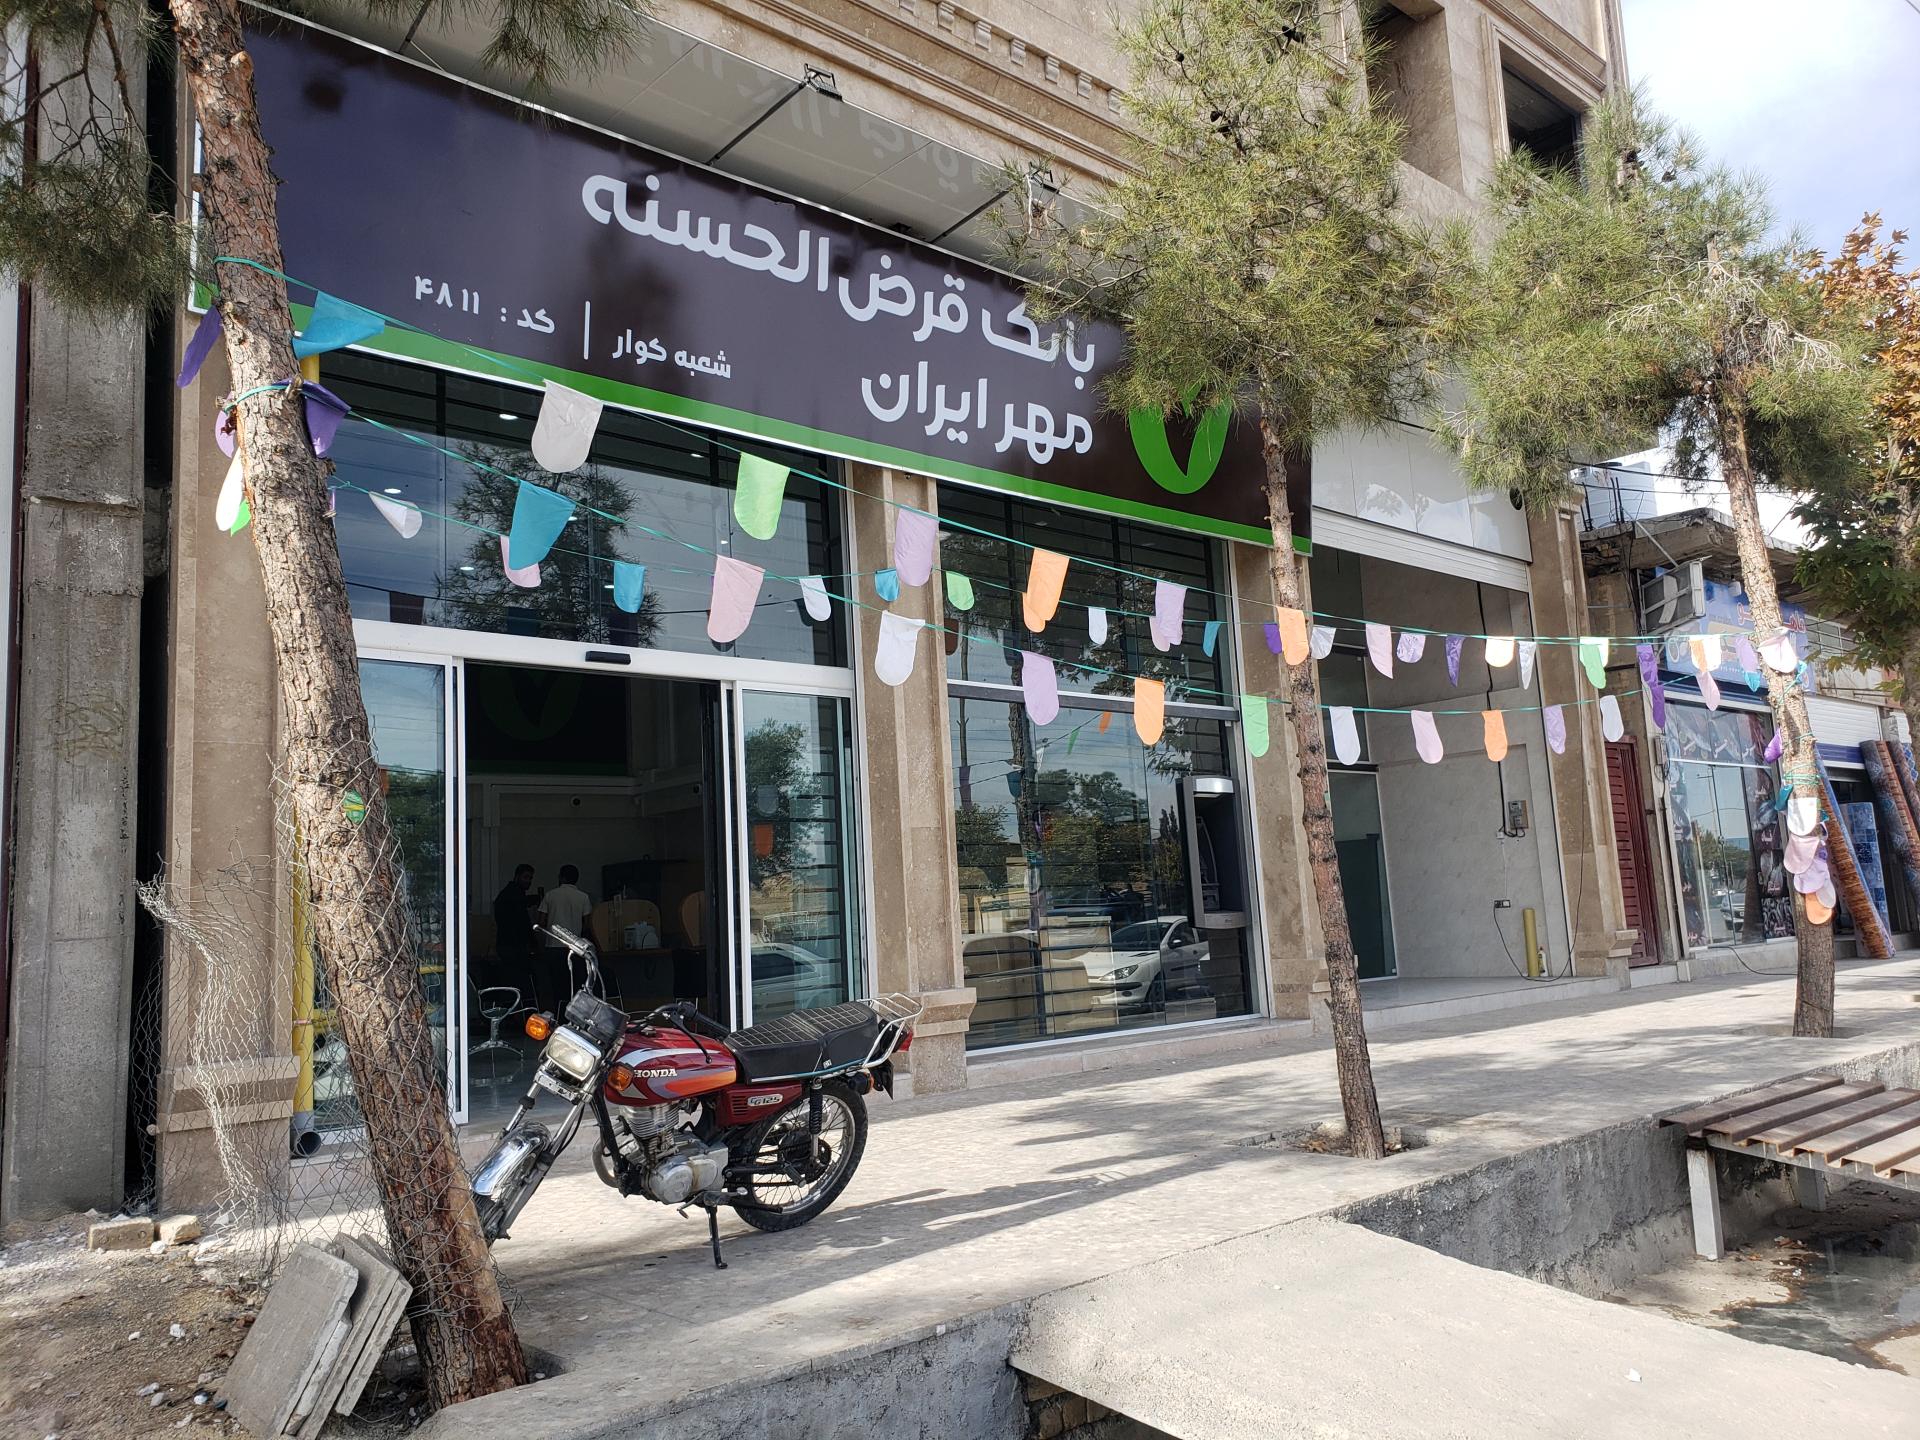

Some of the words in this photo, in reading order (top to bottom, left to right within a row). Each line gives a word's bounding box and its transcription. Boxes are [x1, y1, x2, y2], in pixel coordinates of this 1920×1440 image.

[581, 174, 830, 292] الحسنه
[838, 254, 969, 342] قرض
[612, 328, 667, 365] کوار
[674, 350, 732, 379] شعبه
[861, 360, 988, 445] ایران
[994, 402, 1093, 465] مهر
[633, 1068, 678, 1078] HONDA
